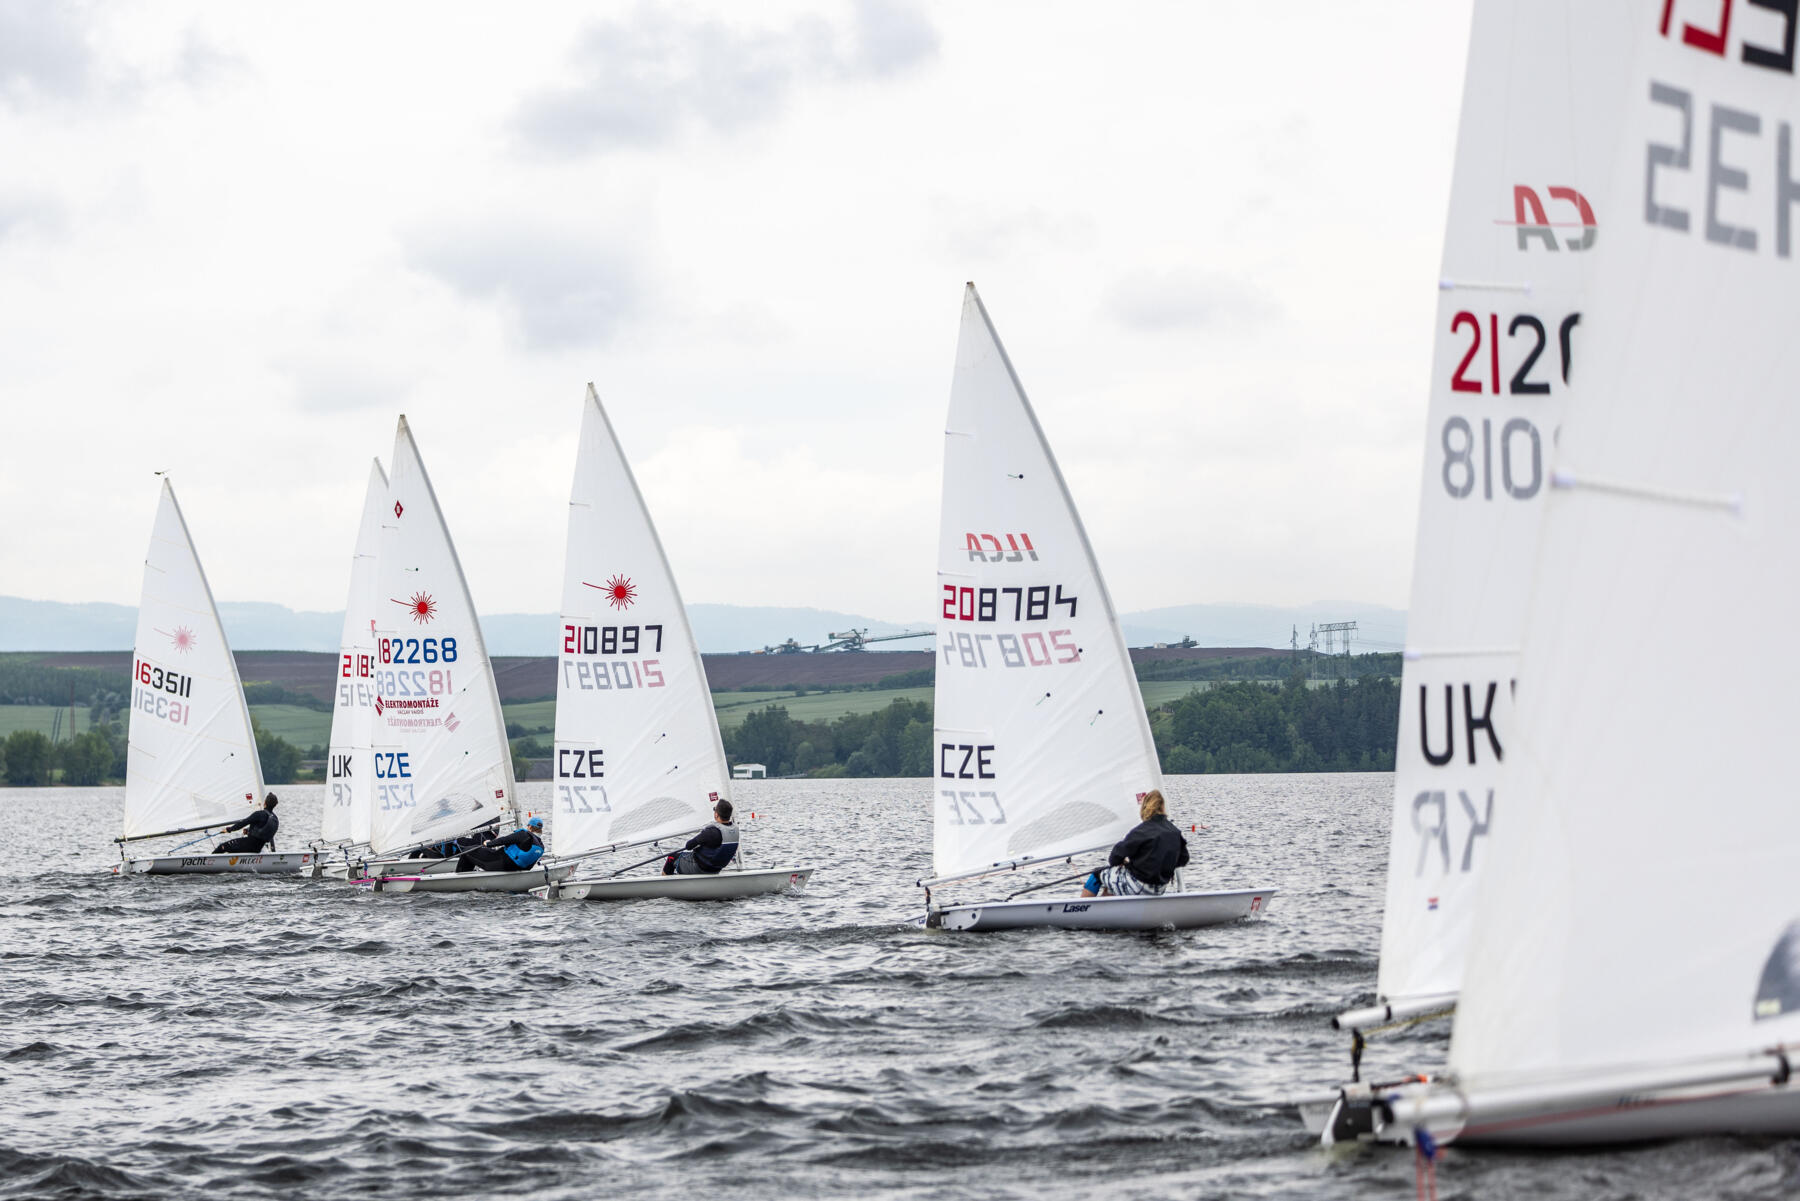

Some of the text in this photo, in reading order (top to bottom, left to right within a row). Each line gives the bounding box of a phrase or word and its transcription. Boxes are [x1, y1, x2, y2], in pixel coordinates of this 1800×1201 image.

[943, 584, 1077, 621] 208784
[378, 637, 457, 664] 182268
[564, 625, 663, 654] 210897
[135, 659, 191, 698] 163511
[385, 697, 439, 708] ELEKTROMONTÁŽE
[1419, 679, 1518, 767] UK
[375, 752, 412, 778] CZE
[559, 749, 604, 777] CZE
[941, 743, 996, 779] CZE
[1063, 903, 1091, 913] Laser
